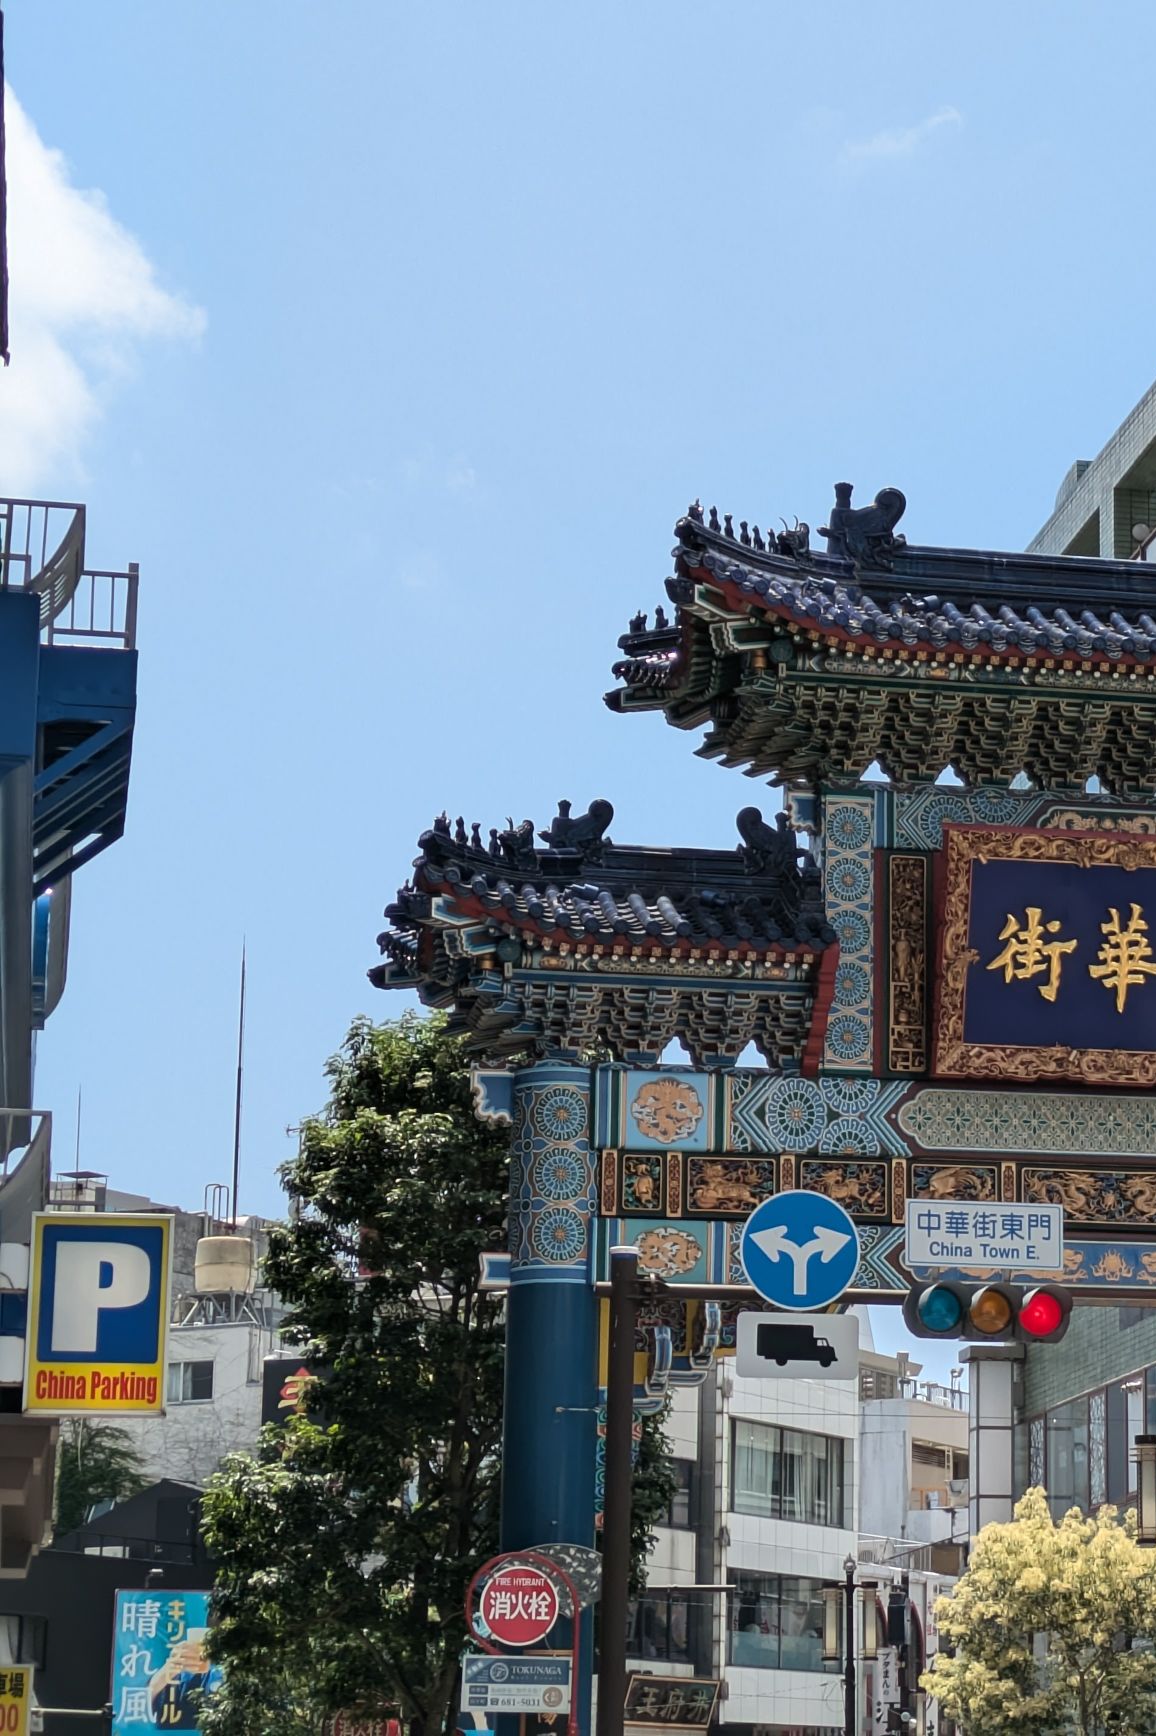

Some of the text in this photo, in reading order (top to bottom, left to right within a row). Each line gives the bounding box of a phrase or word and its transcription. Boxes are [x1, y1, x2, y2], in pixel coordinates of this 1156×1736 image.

[917, 1209, 1051, 1241] 中華街東門
[929, 1241, 1040, 1260] China Town E.
[51, 1240, 151, 1352] P
[36, 1369, 157, 1404] China Parking
[495, 1577, 545, 1587] FIRE HYDRANT
[488, 1591, 552, 1621] 消火栓
[116, 1600, 160, 1725] 晴れ風
[511, 1665, 562, 1675] TOKUNAGA
